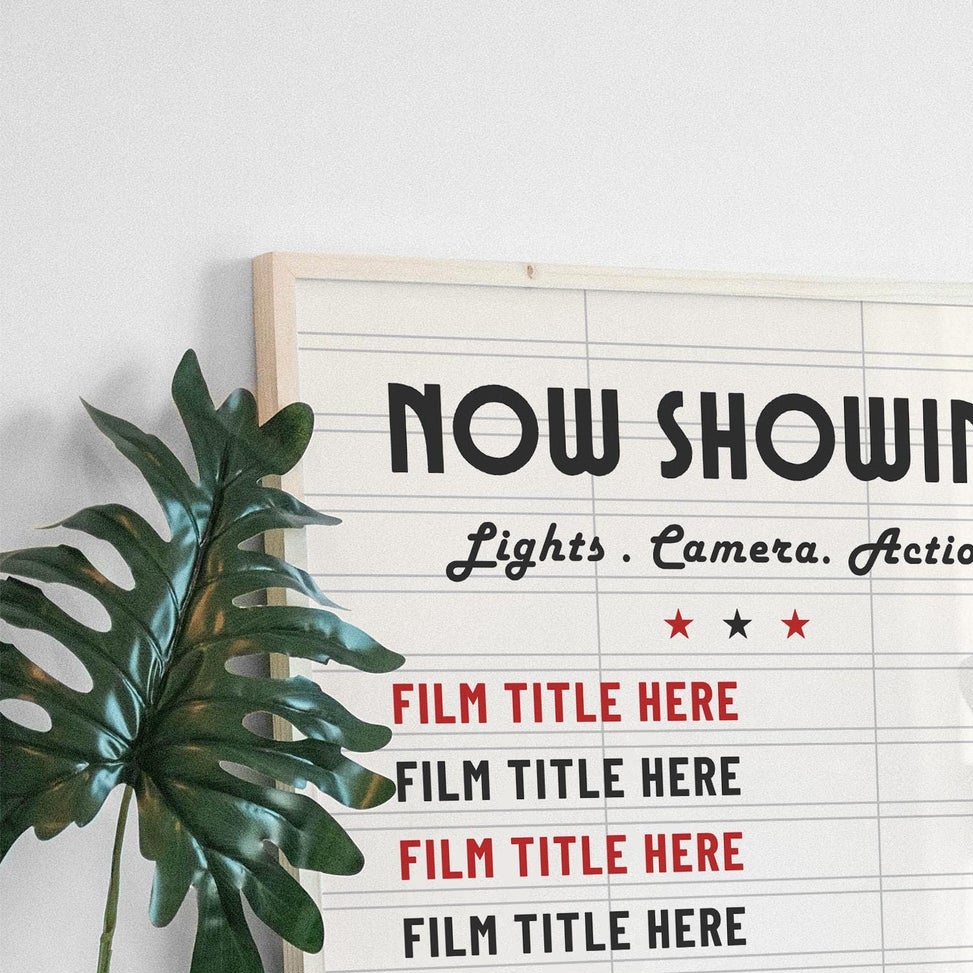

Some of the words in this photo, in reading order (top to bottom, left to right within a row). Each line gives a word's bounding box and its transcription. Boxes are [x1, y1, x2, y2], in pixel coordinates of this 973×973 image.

[387, 382, 621, 477] NOW
[445, 521, 605, 583] Lights
[650, 523, 831, 570] Camera.
[392, 682, 487, 725] FILM
[503, 681, 622, 724] TITLE
[638, 681, 739, 722] HERE
[396, 760, 491, 803] FILM
[507, 758, 625, 800] TITLE
[641, 756, 741, 798] HERE
[399, 837, 494, 881] FILM
[510, 834, 628, 877] TITLE
[644, 831, 744, 874] HERE
[403, 915, 497, 959] FILM
[513, 910, 631, 954] TITLE
[647, 906, 747, 949] HERE
